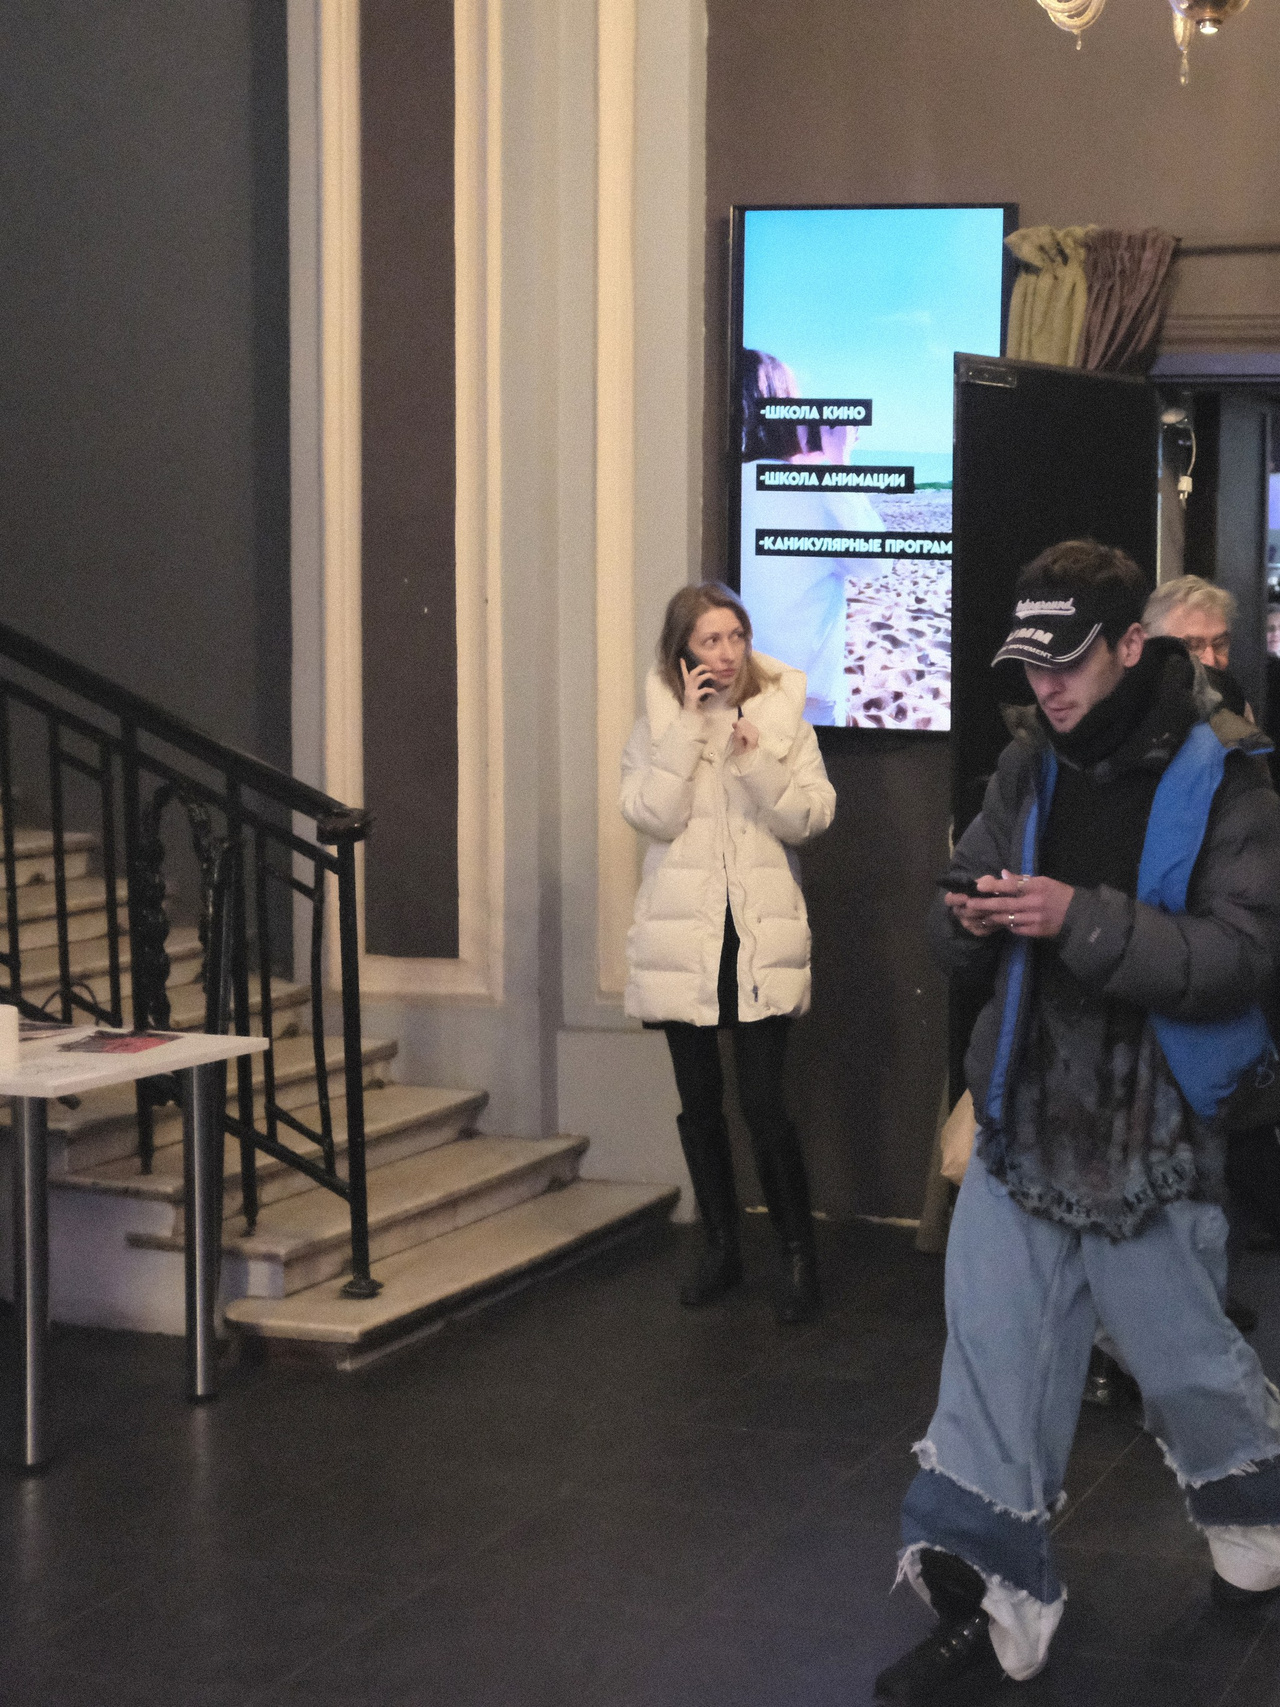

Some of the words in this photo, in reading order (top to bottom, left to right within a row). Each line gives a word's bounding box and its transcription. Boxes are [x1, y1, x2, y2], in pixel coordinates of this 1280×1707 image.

[760, 405, 820, 420] -ШКОЛА
[822, 406, 866, 420] КИНО
[759, 471, 820, 486] -ШКОЛА
[821, 472, 906, 490] АНИМАЦИИ
[758, 536, 882, 553] -КАНИКУЛЯРНЫЕ
